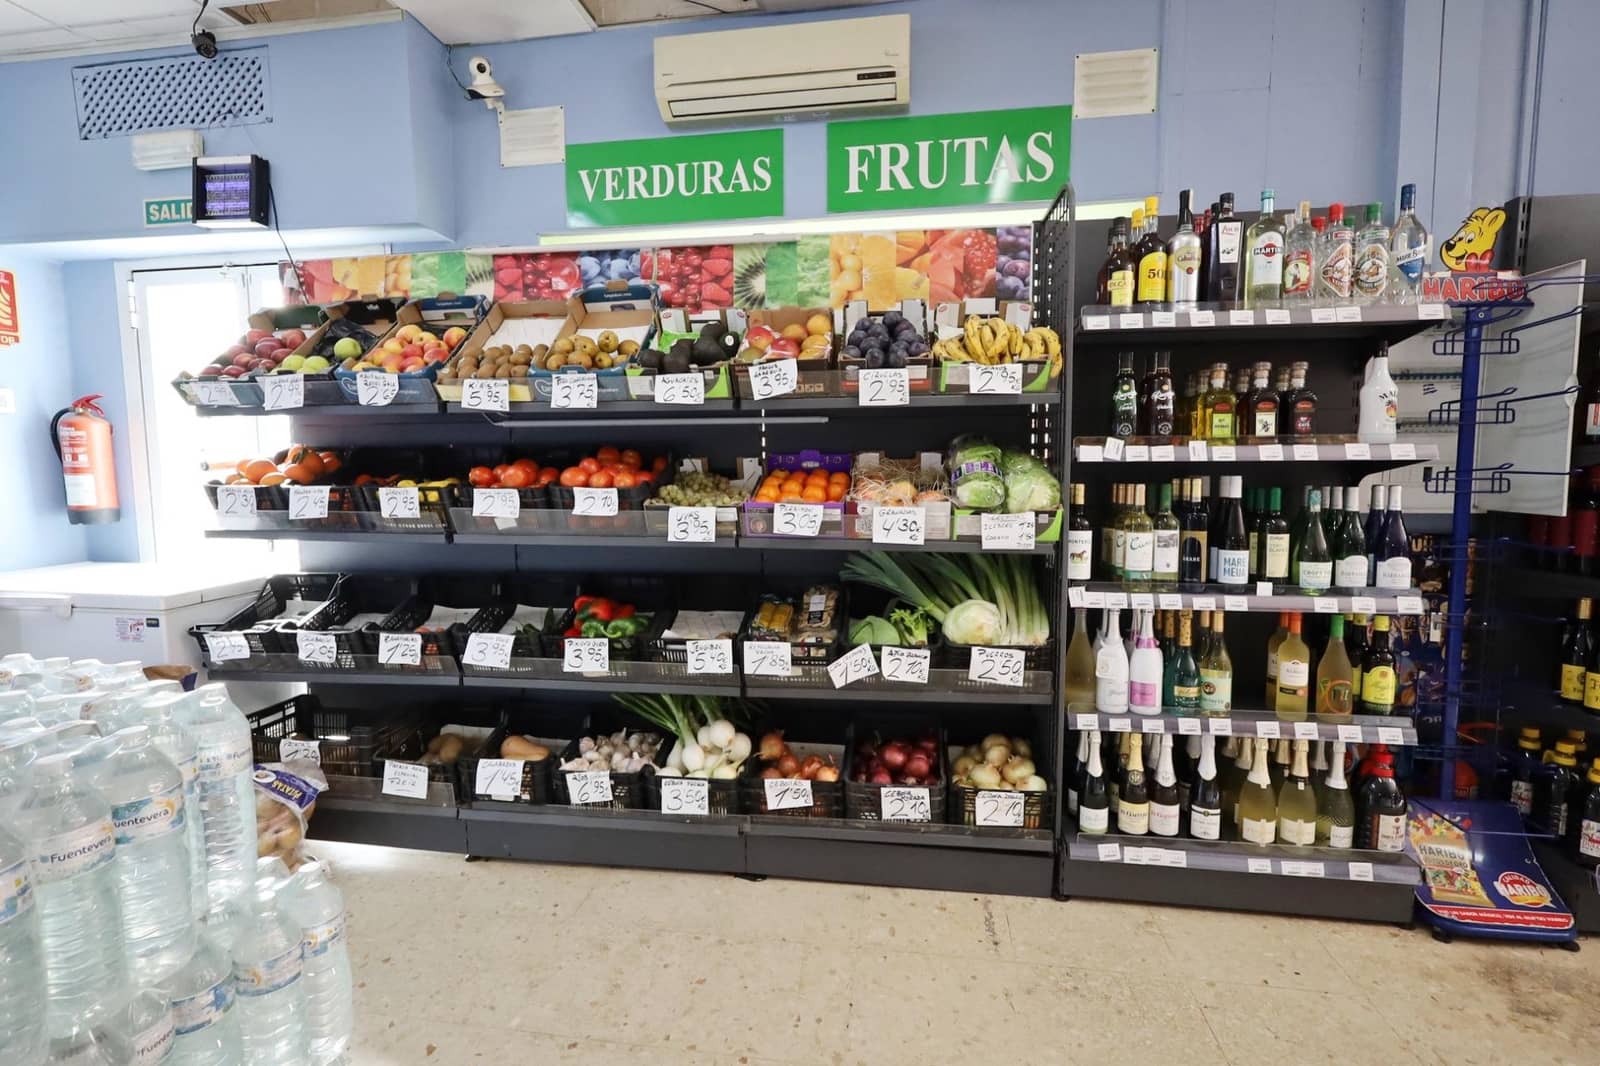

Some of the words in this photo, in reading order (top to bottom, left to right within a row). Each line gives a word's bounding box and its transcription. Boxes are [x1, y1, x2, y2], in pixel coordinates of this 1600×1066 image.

[578, 156, 773, 202] VERDURAS
[844, 131, 1054, 193] FRUTAS
[1423, 277, 1525, 301] HARIBO
[113, 808, 170, 829] uentevera
